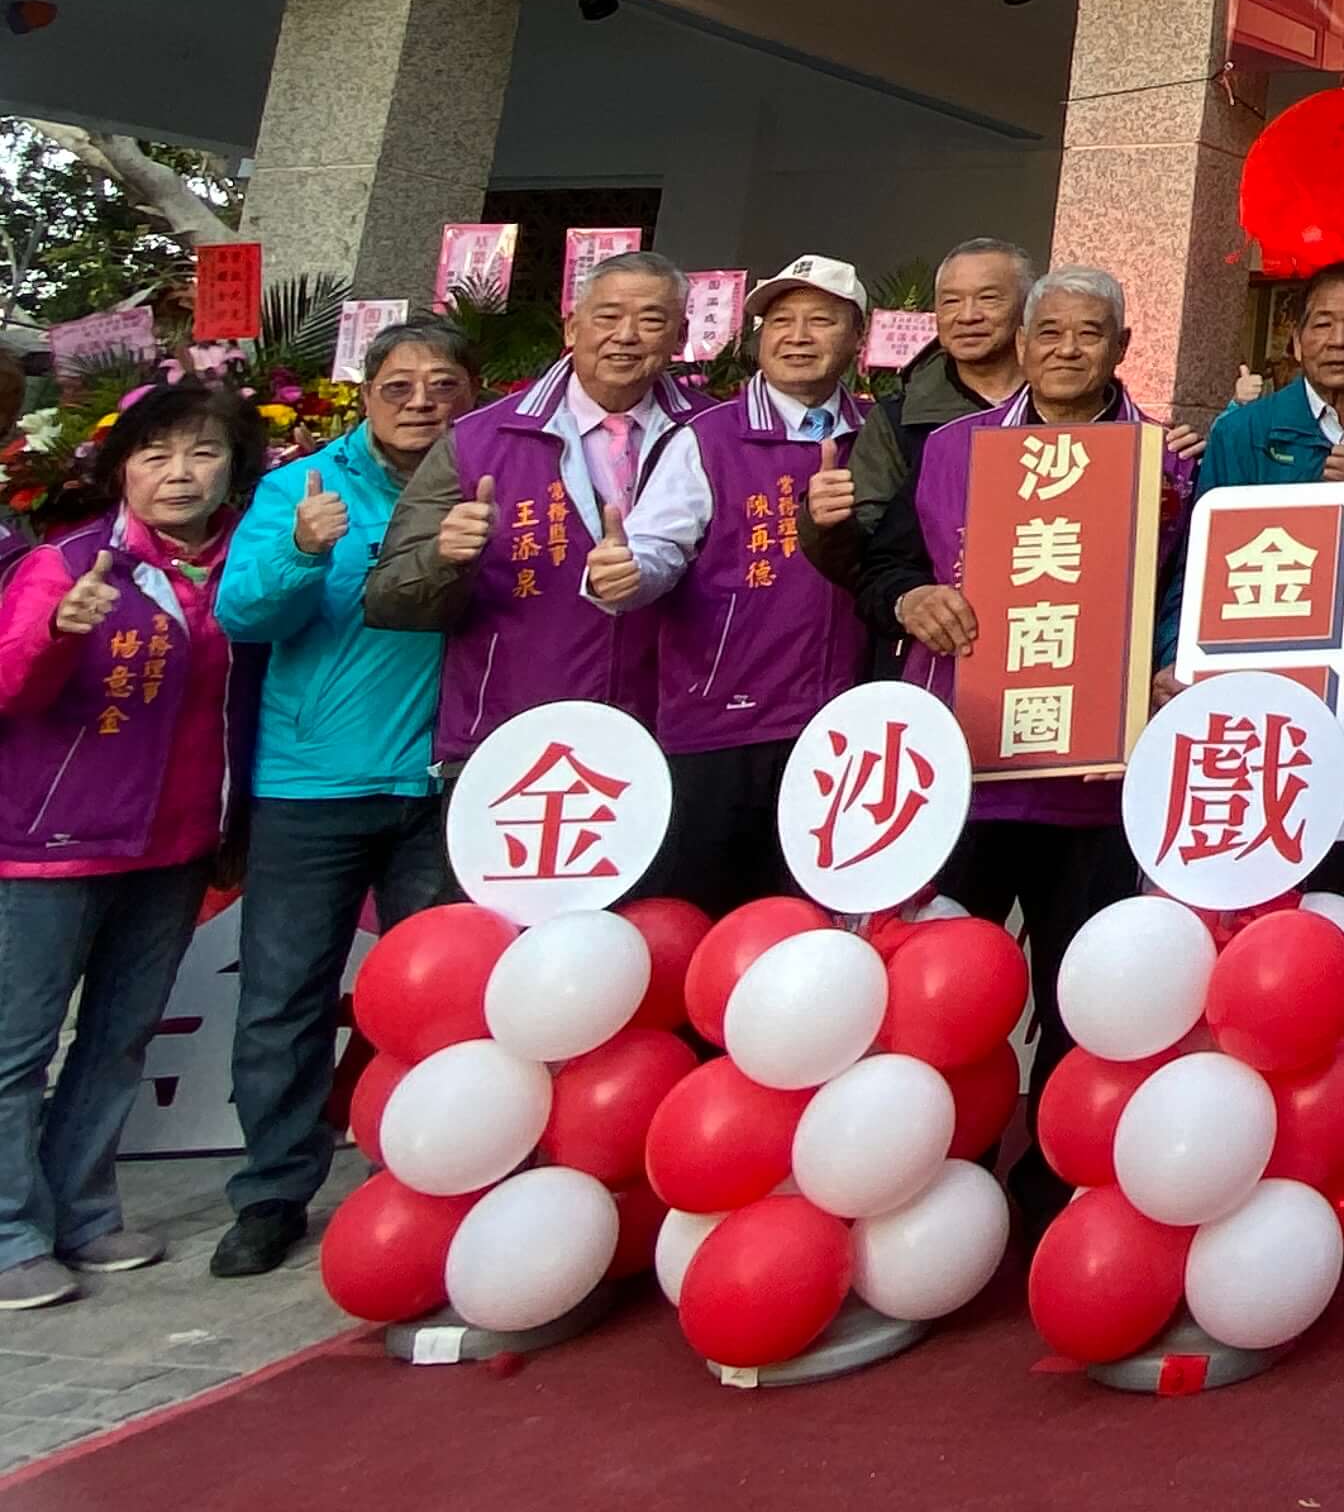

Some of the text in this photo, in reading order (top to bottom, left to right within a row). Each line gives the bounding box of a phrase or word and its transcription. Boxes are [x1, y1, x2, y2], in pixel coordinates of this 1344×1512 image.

[511, 500, 544, 598] 王添泉
[746, 494, 776, 588] 陳再德
[1000, 432, 1091, 758] 沙美商圈
[483, 740, 632, 882] 金
[809, 721, 935, 871] 沙
[1154, 712, 1316, 867] 戲
